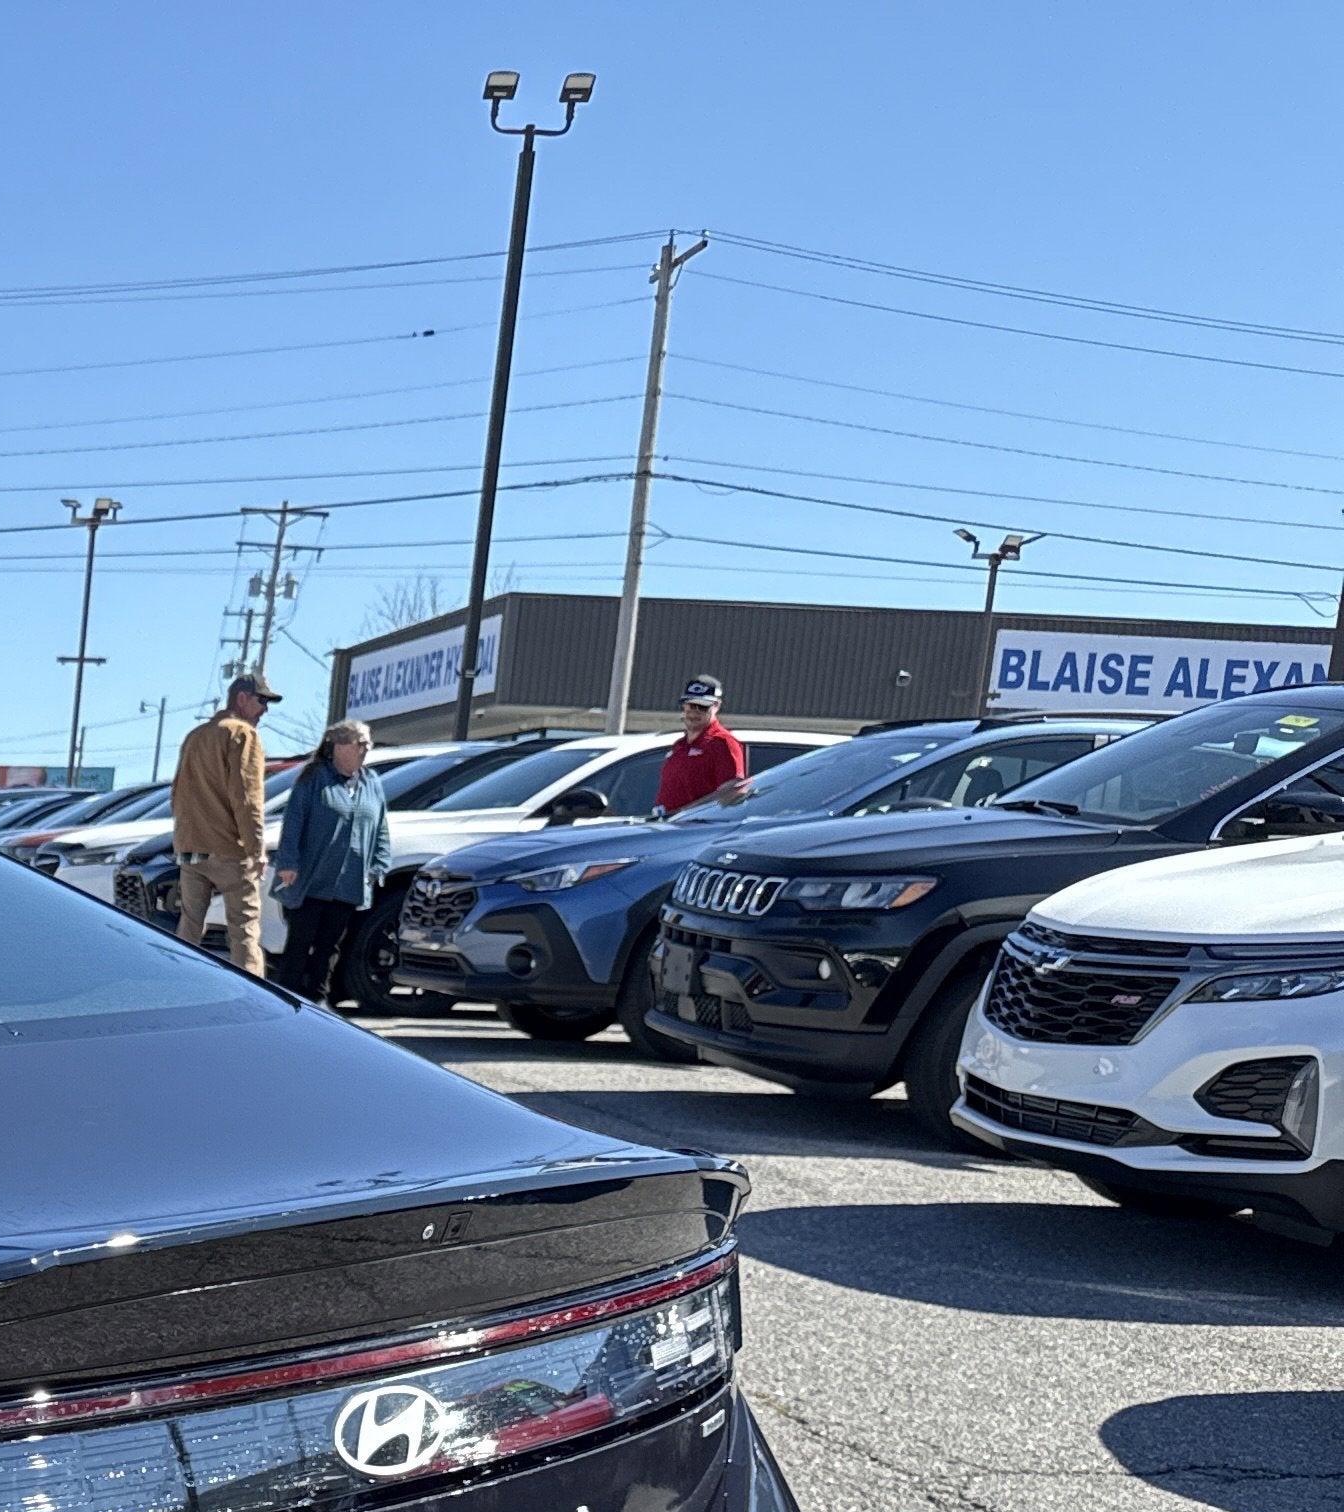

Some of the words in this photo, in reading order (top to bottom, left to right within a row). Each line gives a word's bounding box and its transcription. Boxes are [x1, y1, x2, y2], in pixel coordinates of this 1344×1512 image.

[347, 665, 383, 710] BLAISE
[381, 648, 444, 702] ALEXANDER
[998, 648, 1154, 696] BLAISE
